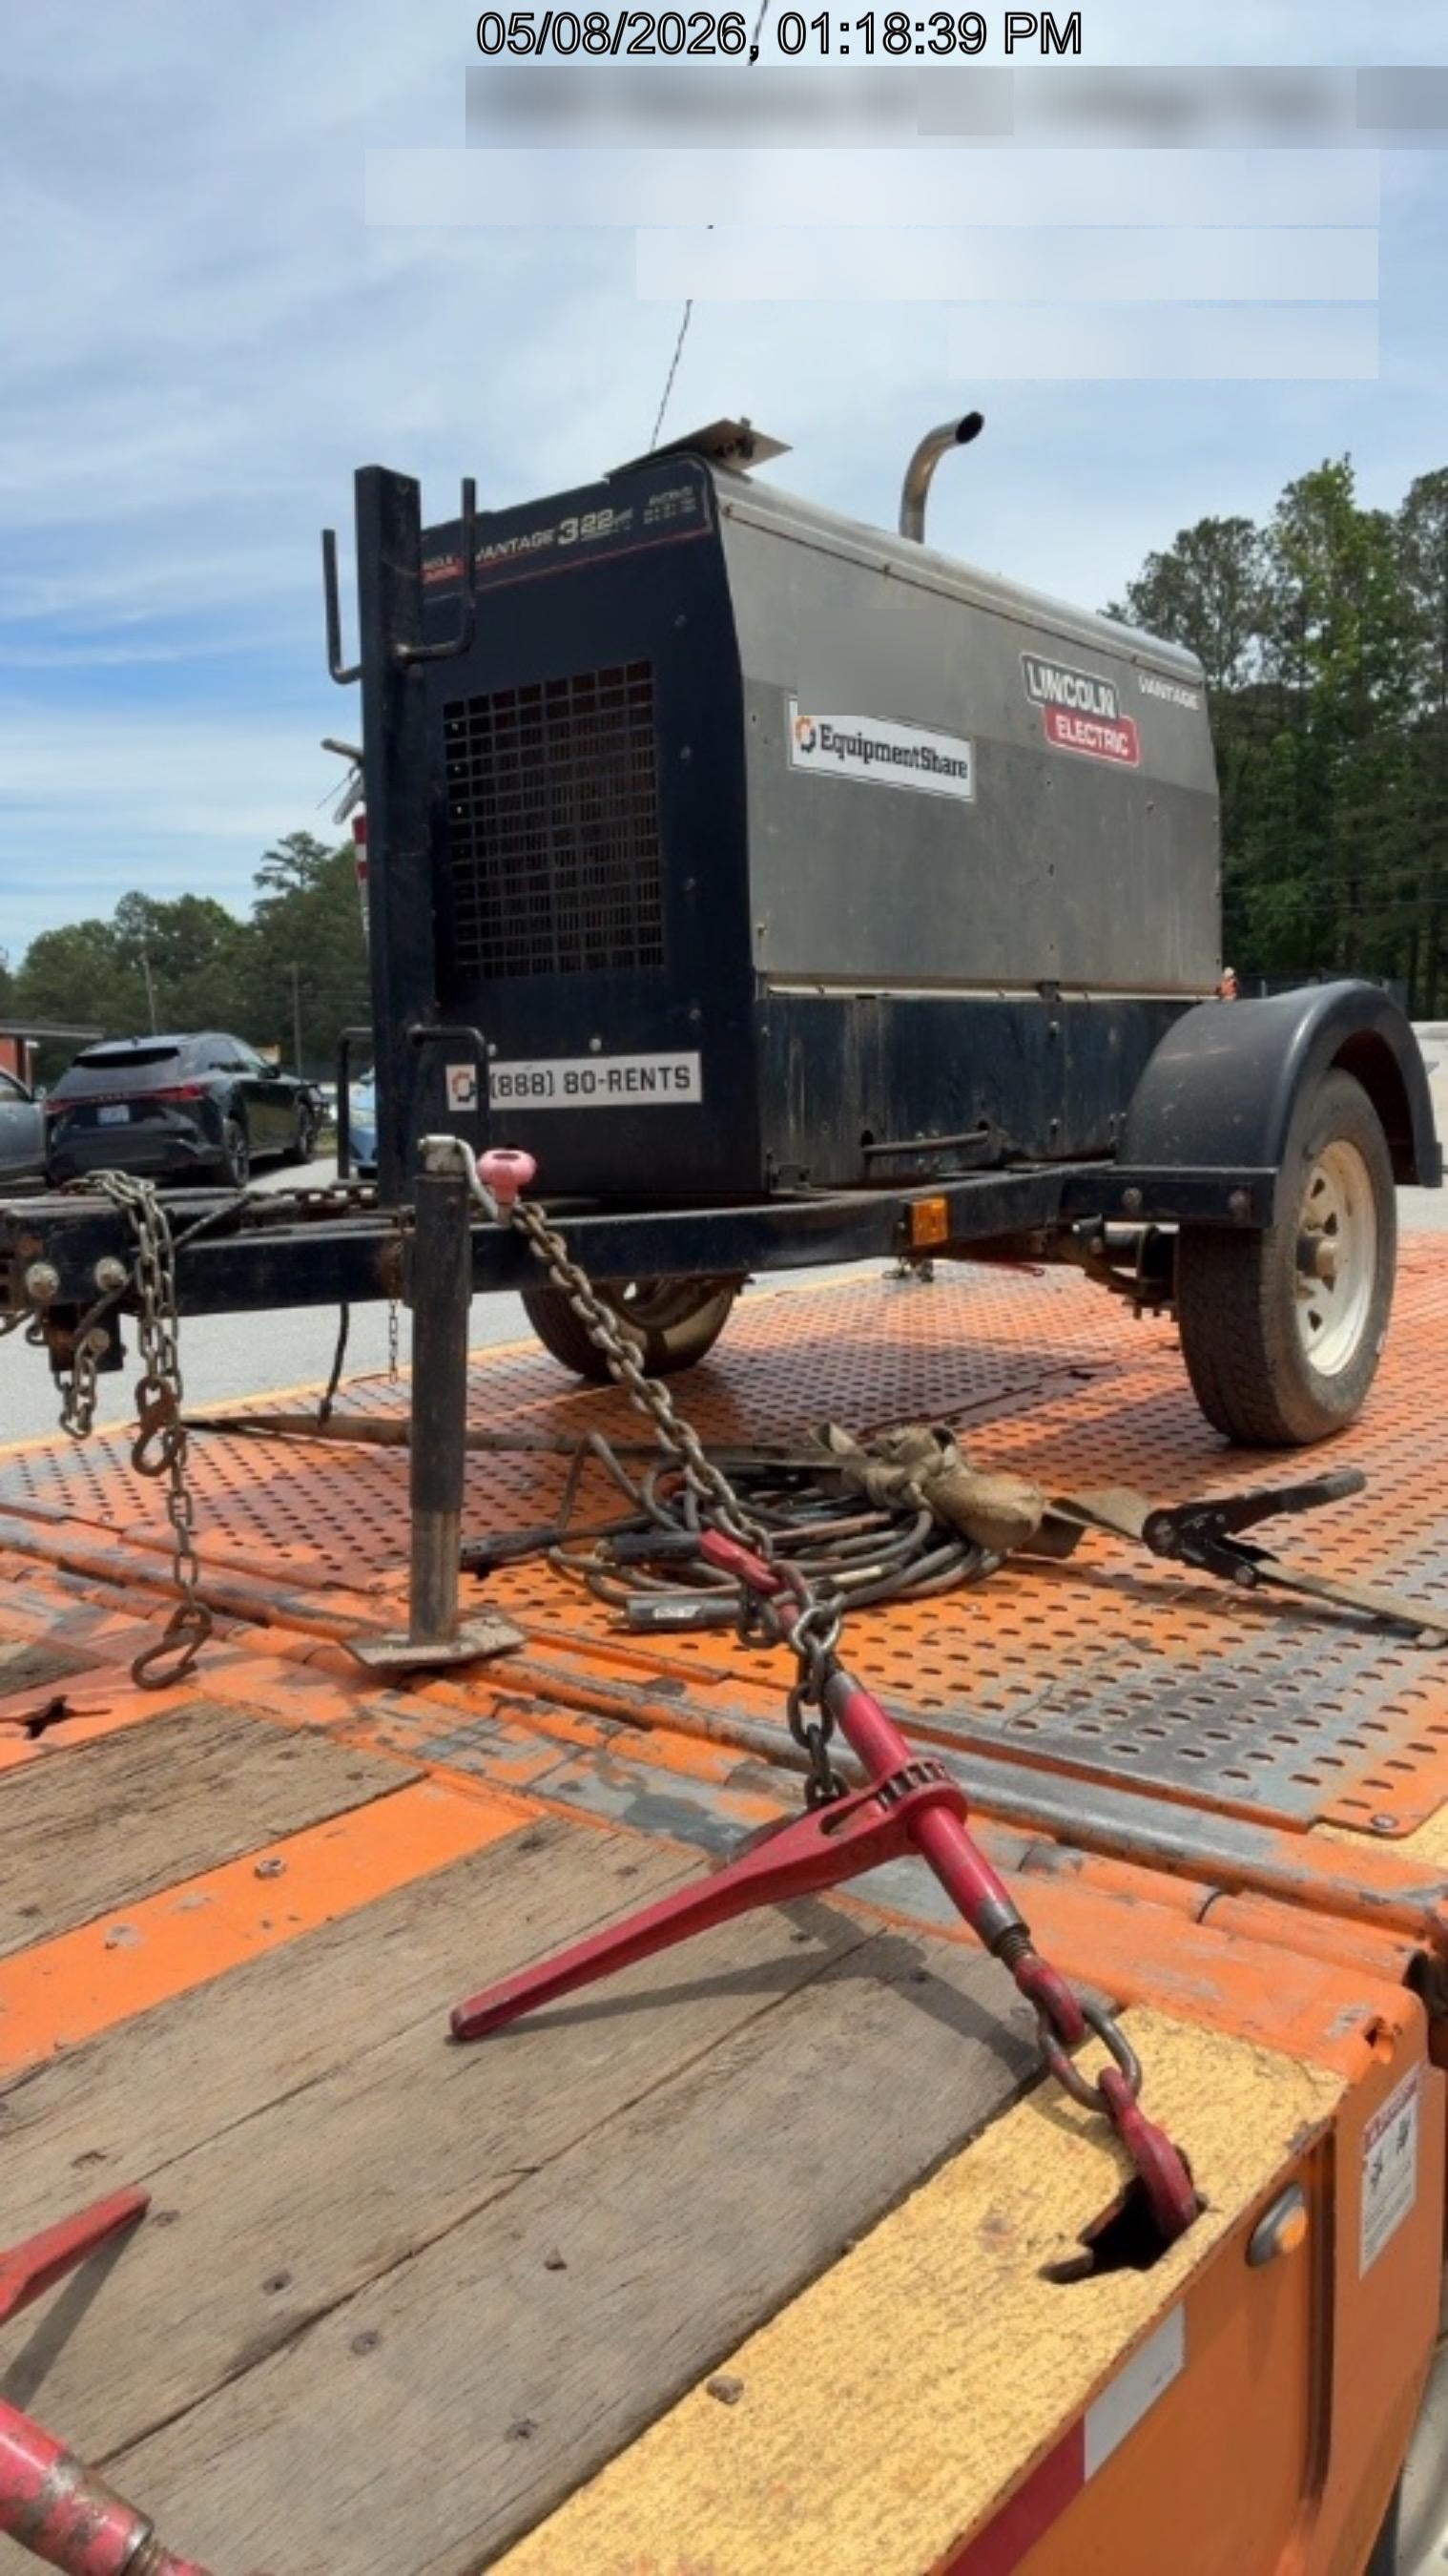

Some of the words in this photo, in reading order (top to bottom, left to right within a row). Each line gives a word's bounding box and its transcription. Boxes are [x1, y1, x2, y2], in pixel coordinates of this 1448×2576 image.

[556, 508, 615, 546] 322
[1026, 660, 1117, 720] LINCOLN
[1137, 674, 1200, 712] VANTAGE
[819, 723, 969, 779] EquipmentShare
[1054, 714, 1129, 757] ELECTRIC
[564, 1065, 692, 1095] 80-RENTS
